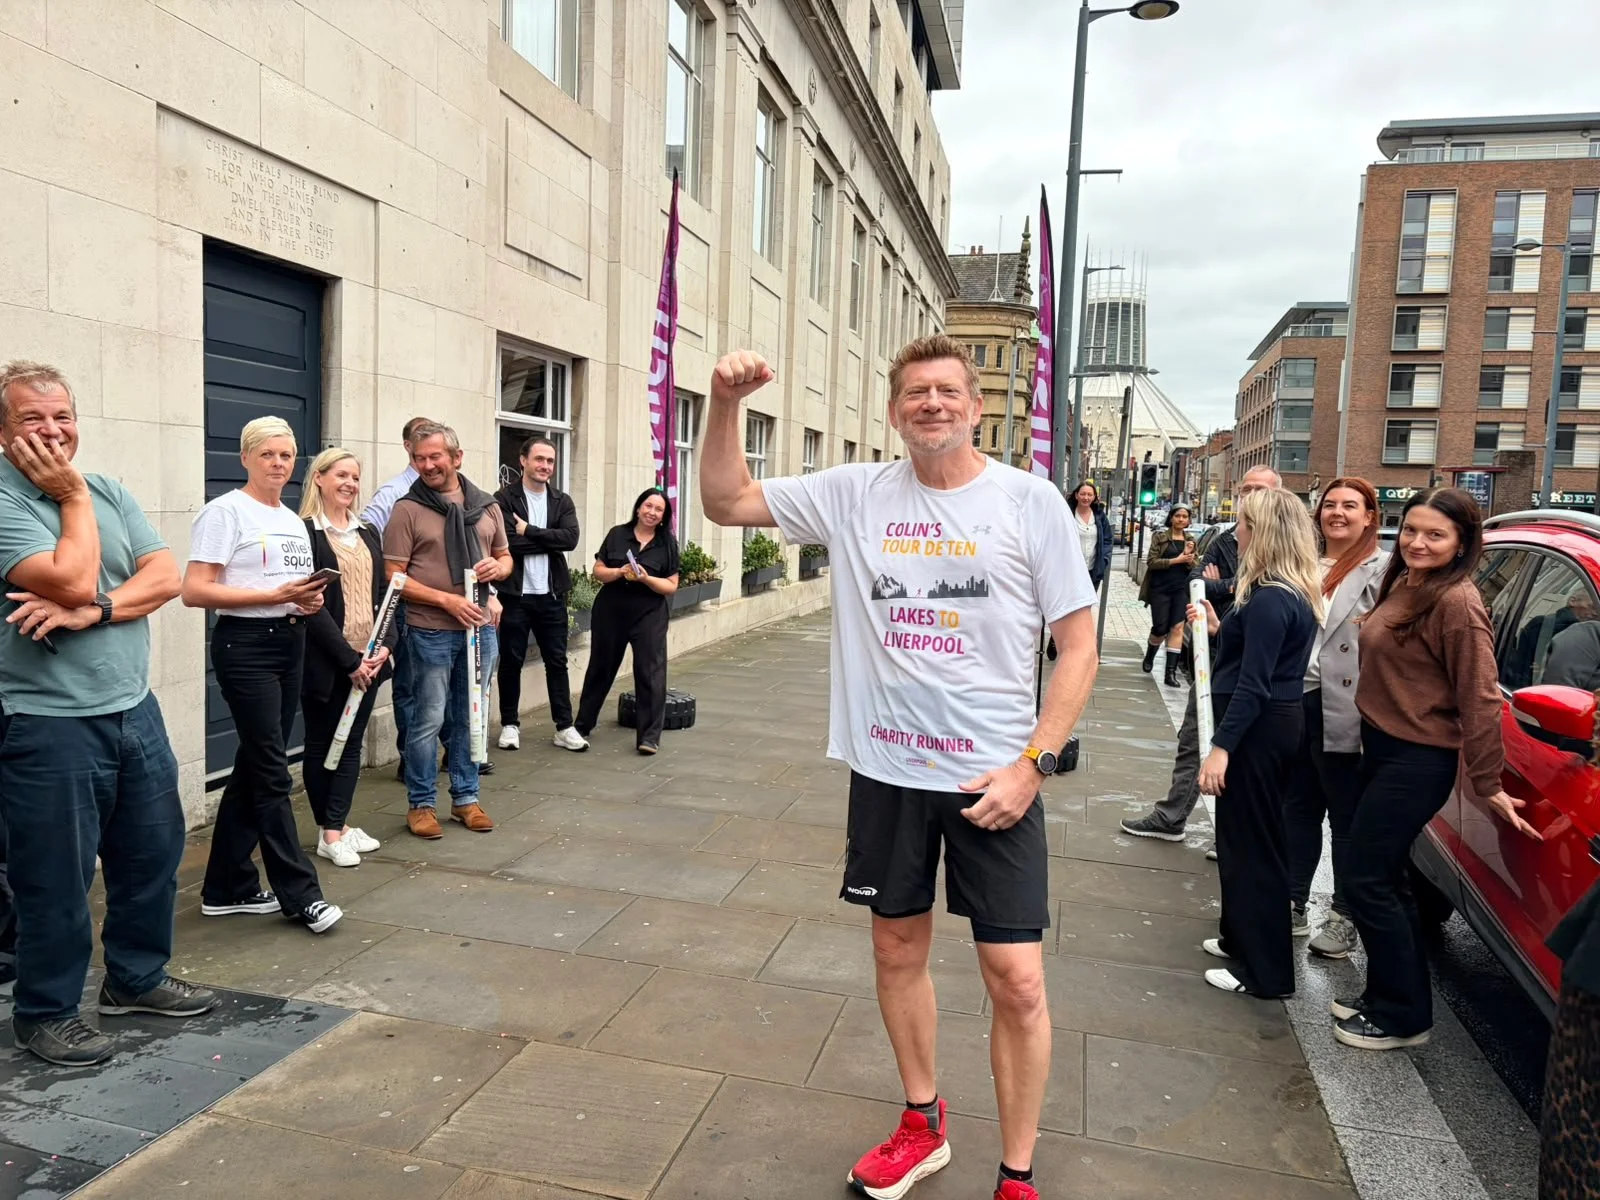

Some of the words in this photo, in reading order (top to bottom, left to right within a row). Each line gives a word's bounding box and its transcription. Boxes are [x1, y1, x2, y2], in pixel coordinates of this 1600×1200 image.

[206, 139, 243, 164] CHRIST
[252, 158, 281, 179] HEALS
[289, 174, 306, 190] THE
[222, 160, 242, 177] FOR
[249, 170, 274, 189] WHO
[283, 184, 315, 206] DENIES
[206, 167, 234, 188] THAT
[243, 182, 254, 195] IN
[262, 190, 281, 206] THE
[288, 201, 313, 218] MIND
[232, 192, 264, 213] DWELL
[272, 206, 301, 227] TRUER
[309, 221, 334, 239] SIGHT
[232, 207, 253, 222] AND
[260, 217, 301, 240] CLEARER
[309, 233, 334, 251] LIGHT
[224, 217, 252, 236] THAN
[260, 231, 271, 243] IN
[279, 236, 297, 251] THE
[305, 244, 330, 260] EYES?
[1531, 491, 1596, 504] SREET
[882, 539, 921, 554] TOUR
[924, 540, 943, 556] DE
[947, 540, 977, 556] TEN
[886, 522, 942, 538] COLIN'S
[379, 609, 395, 639] confetti
[389, 594, 400, 608] XXL
[889, 606, 935, 626] LAKES
[939, 610, 960, 628] TO
[884, 631, 965, 654] LIVERPOOL
[870, 724, 914, 747] CHARITY
[917, 734, 975, 752] RUNNER
